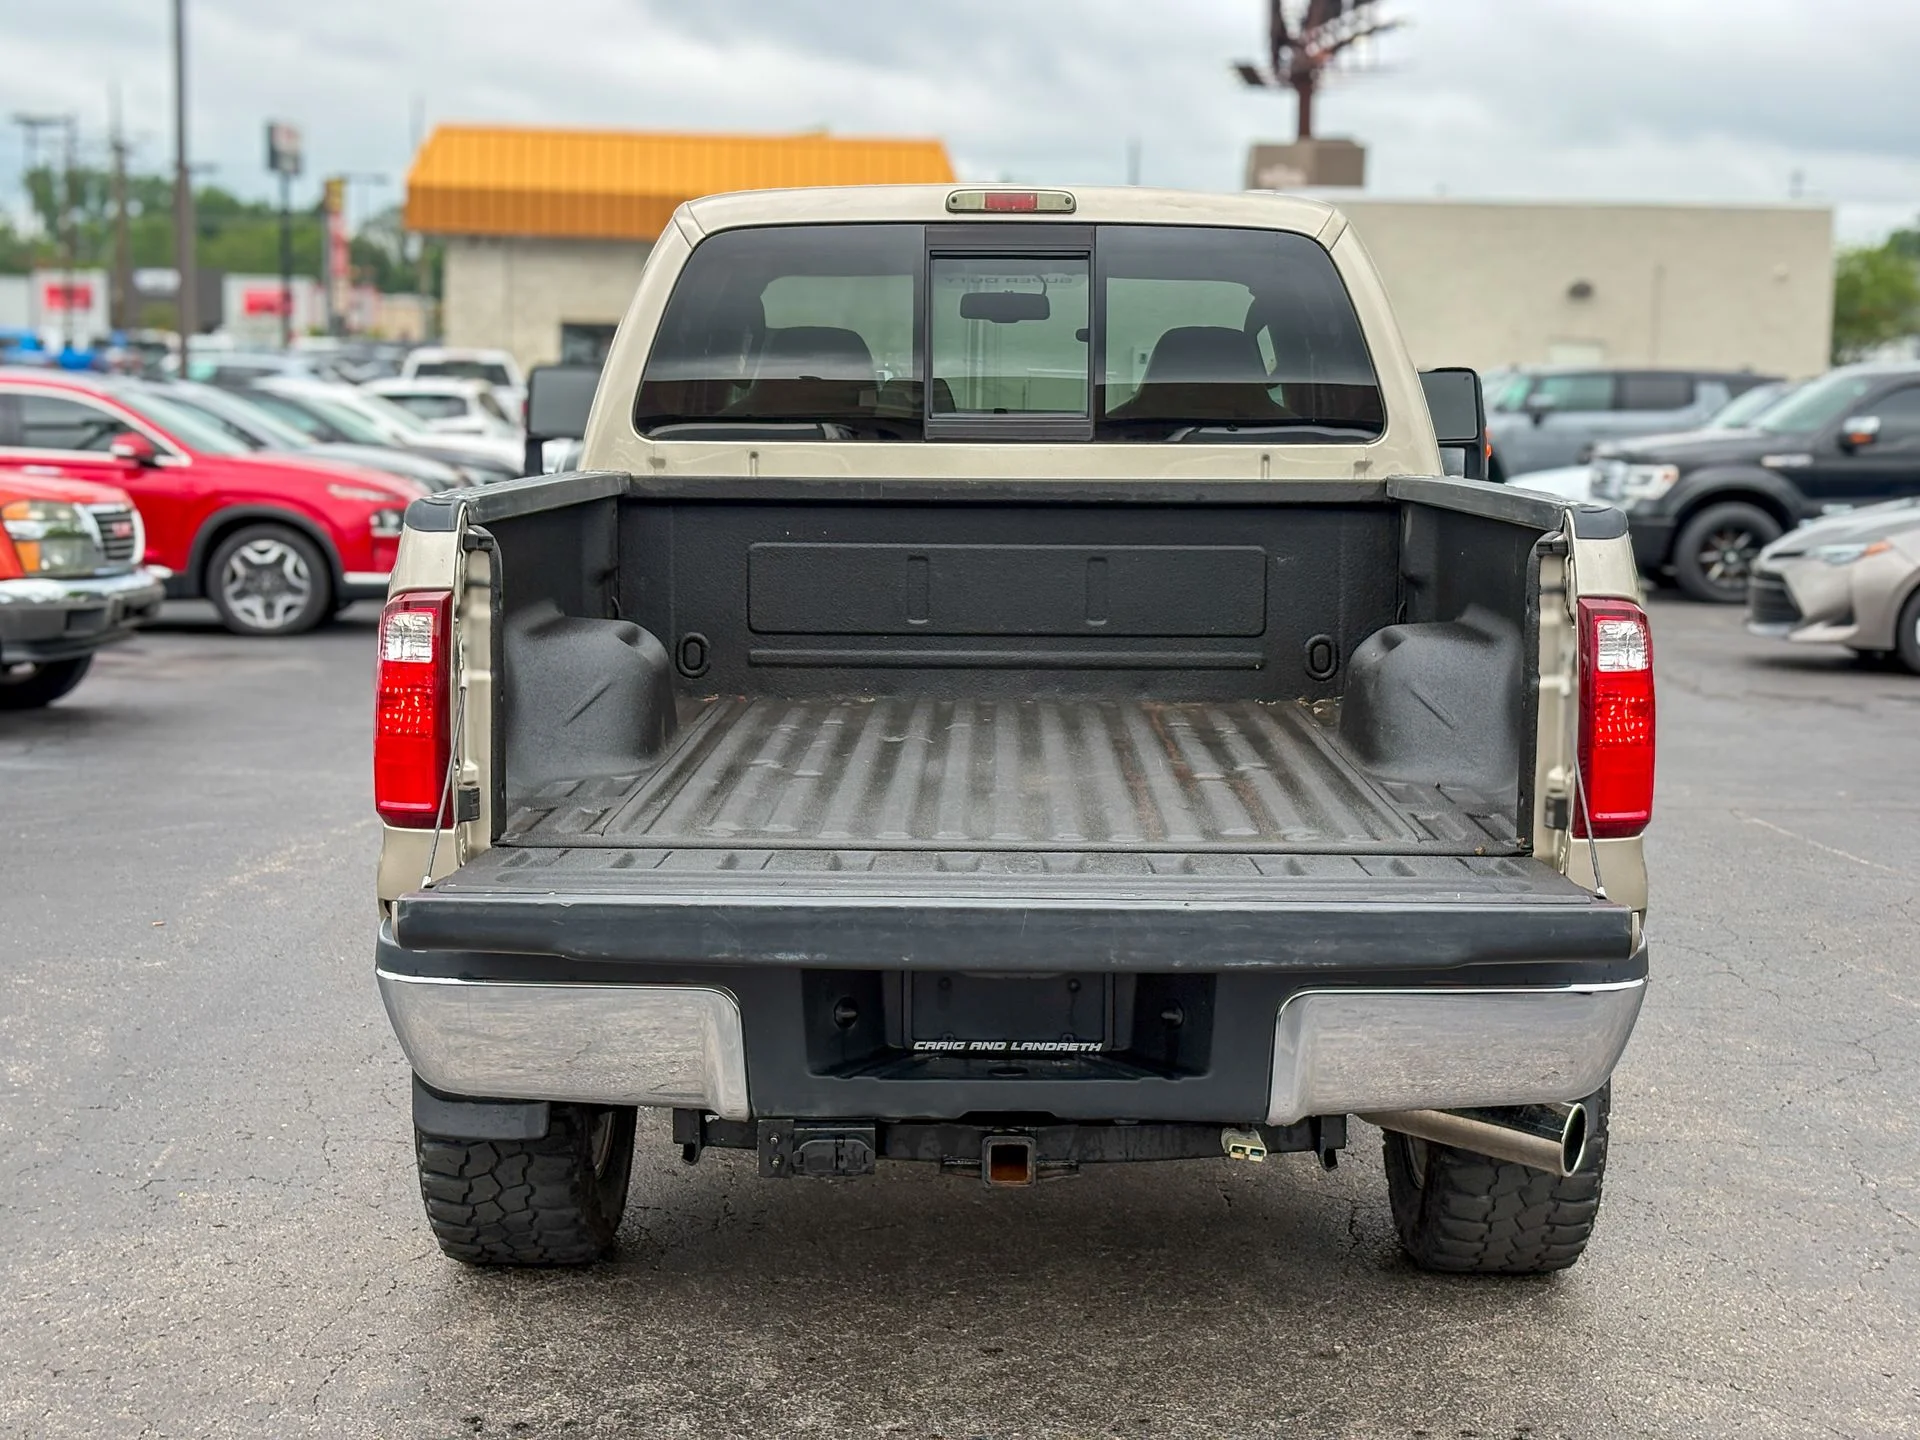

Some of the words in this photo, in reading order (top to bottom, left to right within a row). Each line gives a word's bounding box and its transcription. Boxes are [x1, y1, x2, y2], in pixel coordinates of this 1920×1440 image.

[913, 1041, 966, 1051] CRAIG
[969, 1041, 1007, 1051] AND
[1010, 1042, 1103, 1052] LANDRETH
